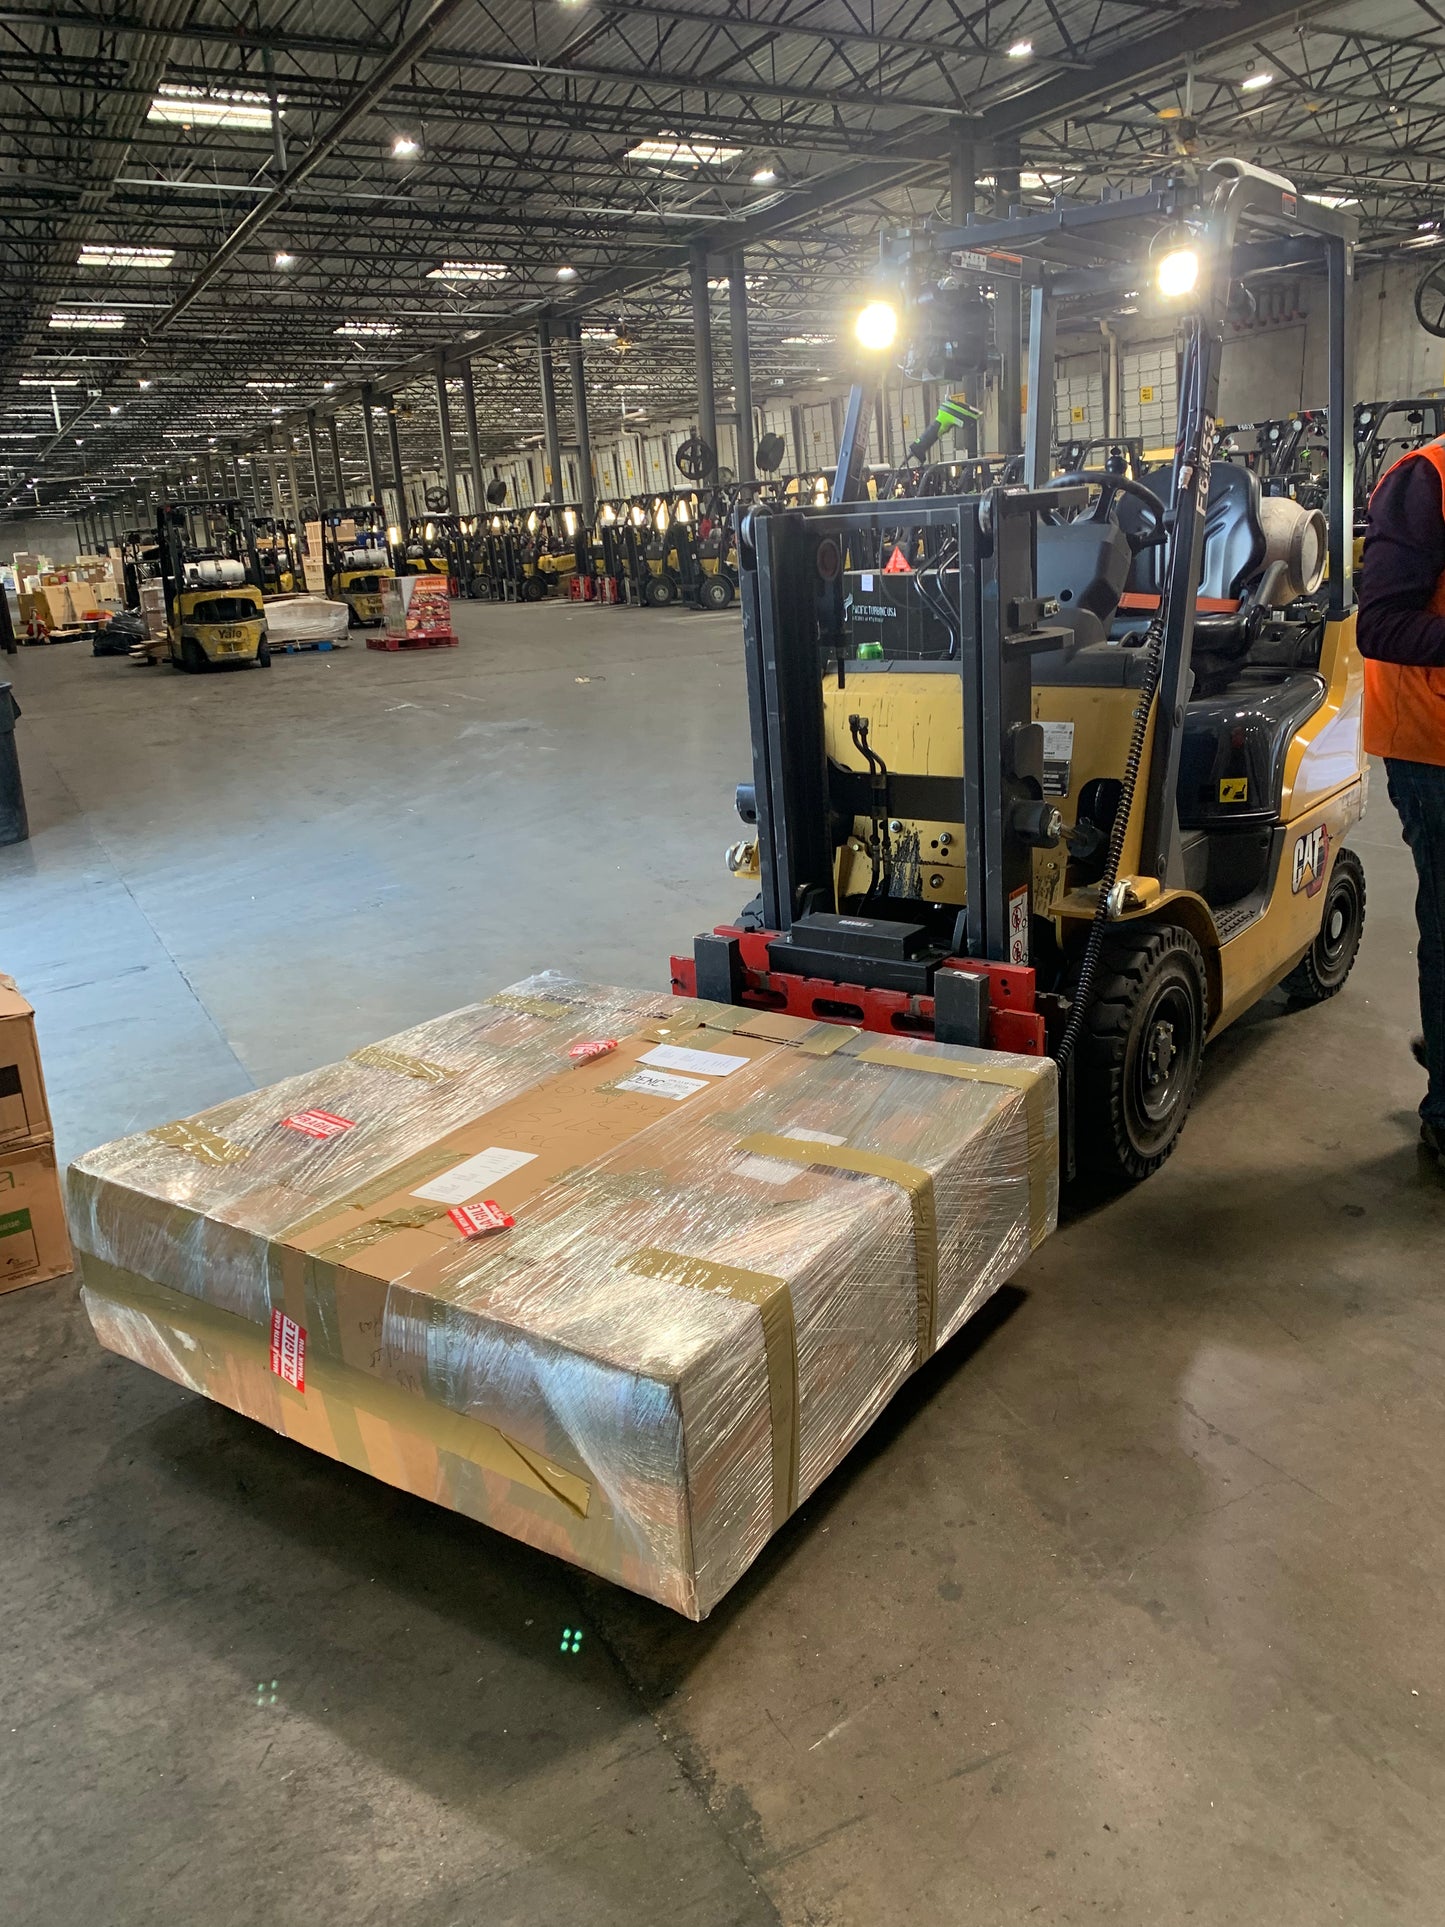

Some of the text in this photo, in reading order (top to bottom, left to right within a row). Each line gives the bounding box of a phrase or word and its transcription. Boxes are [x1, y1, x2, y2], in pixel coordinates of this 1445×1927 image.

[887, 606, 897, 617] USA
[218, 629, 242, 639] Yale
[1292, 826, 1323, 893] CAT
[295, 1115, 341, 1133] FRAGILE
[274, 1310, 282, 1330] CARE
[273, 1330, 281, 1348] WITH
[284, 1319, 297, 1384] FRAGILE
[297, 1355, 305, 1382] THANK
